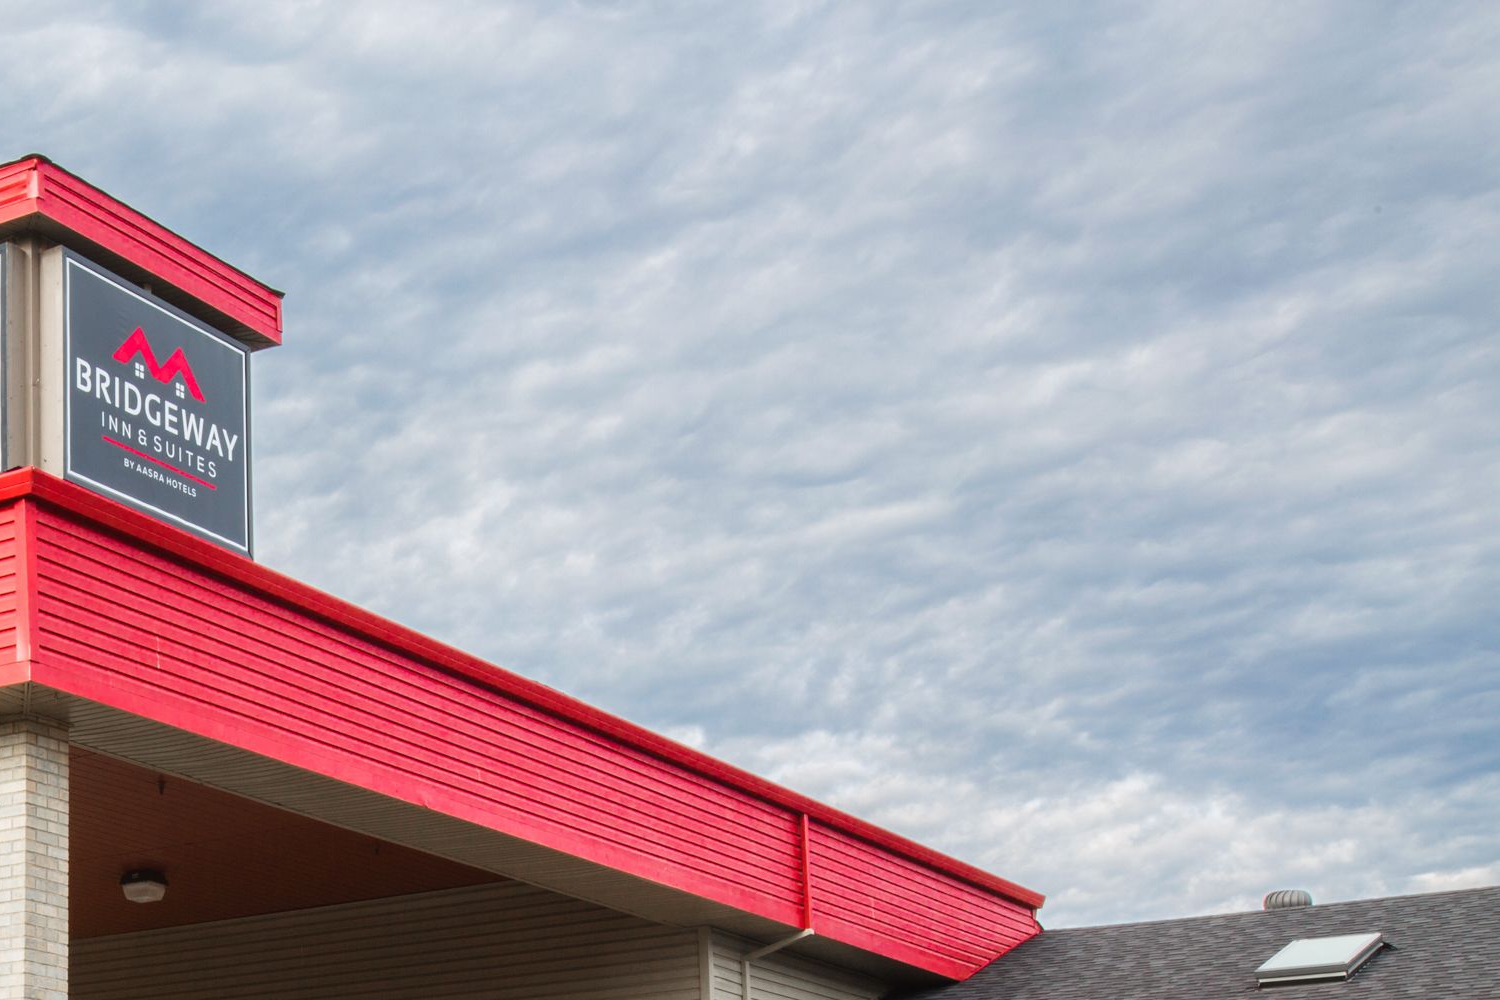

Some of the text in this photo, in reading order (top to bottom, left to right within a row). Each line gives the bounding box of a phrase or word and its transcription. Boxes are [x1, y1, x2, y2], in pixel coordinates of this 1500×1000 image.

[76, 357, 238, 461] BRIDGEWAY
[101, 411, 217, 478] INN & SUITES
[124, 458, 197, 497] BY AASRA HOTELS
